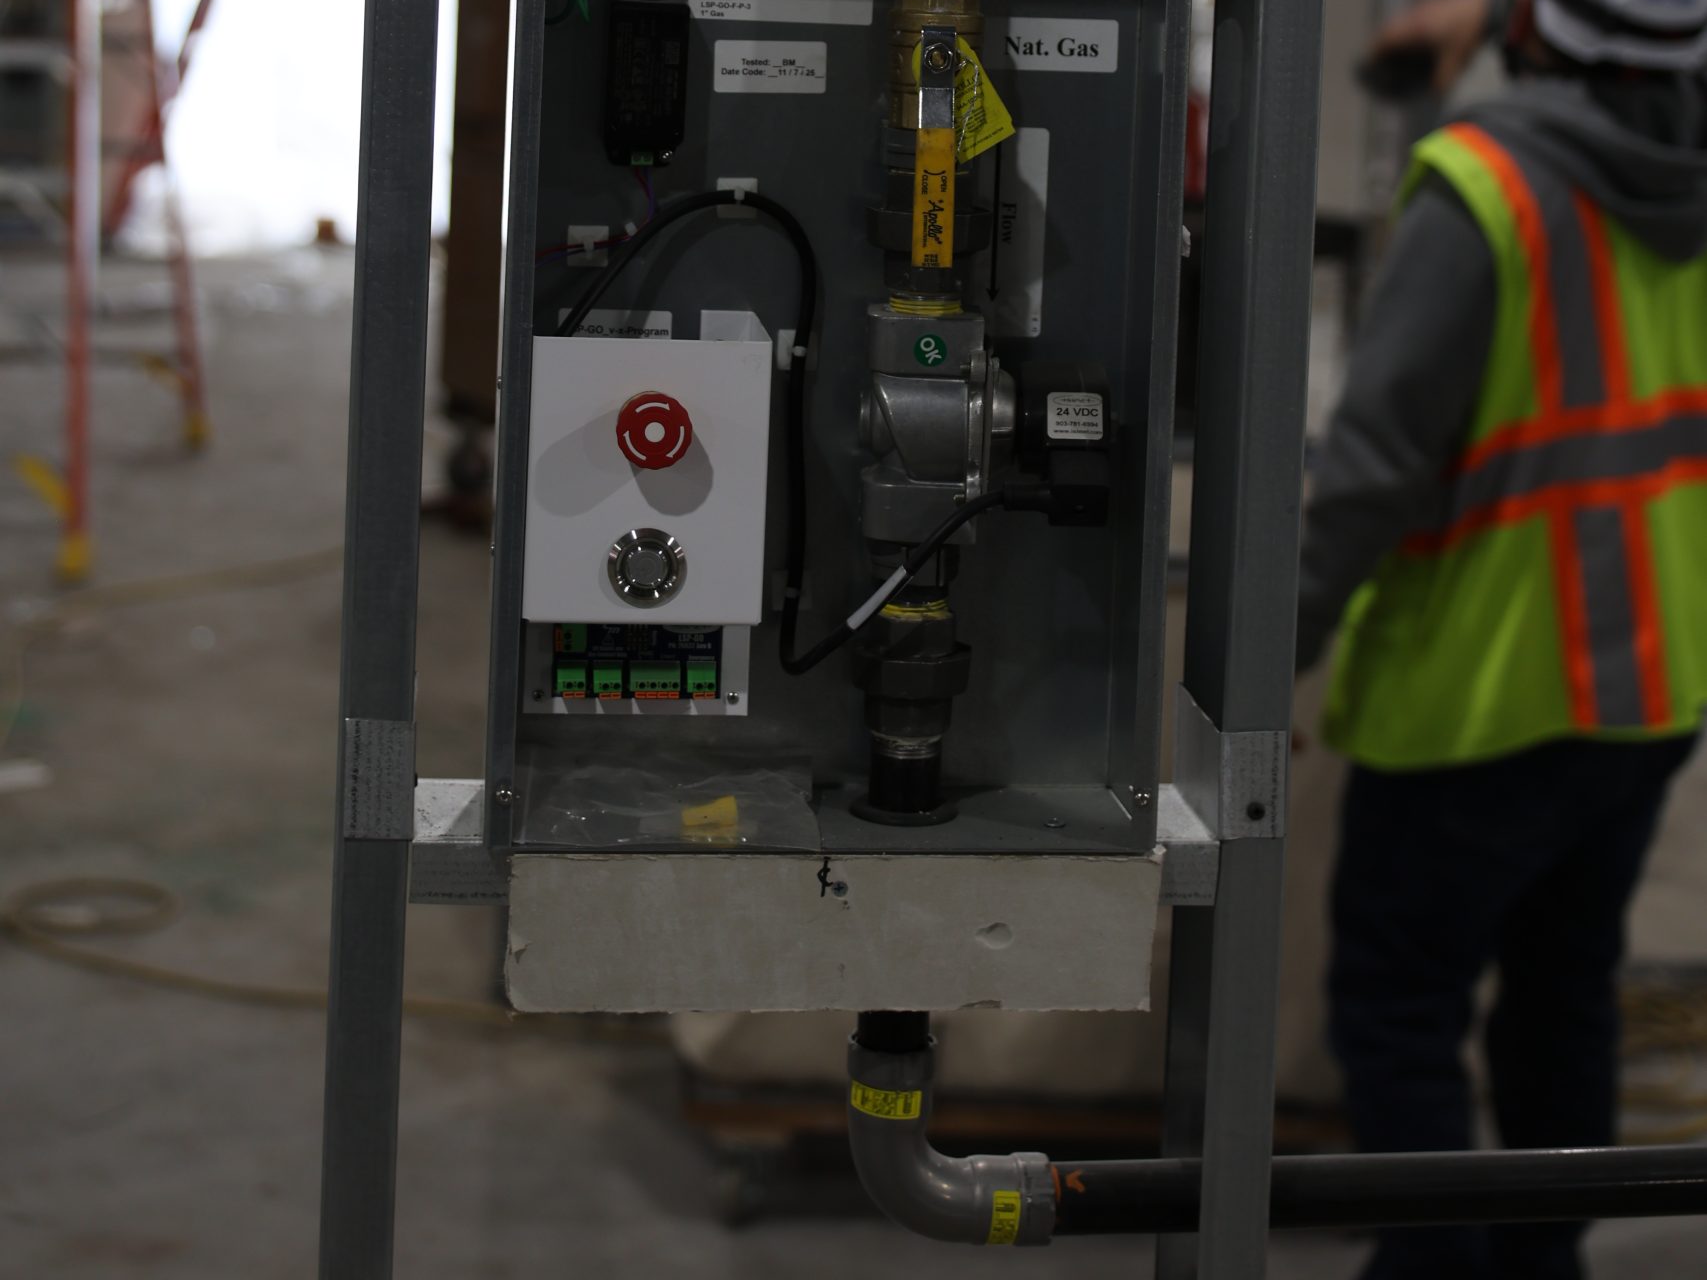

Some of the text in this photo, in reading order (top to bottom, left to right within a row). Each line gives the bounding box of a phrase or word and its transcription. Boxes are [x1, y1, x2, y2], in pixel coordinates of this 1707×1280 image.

[701, 2, 751, 10] LSP-GO-F-P-3
[1004, 36, 1099, 57] Nat. Gas
[741, 58, 771, 66] Tested:
[742, 68, 766, 76] Code:
[921, 174, 929, 196] CLOSE
[940, 175, 948, 193] OPEN
[1001, 202, 1017, 245] Flow
[918, 336, 941, 364] OK
[1056, 407, 1099, 417] 24 VDC
